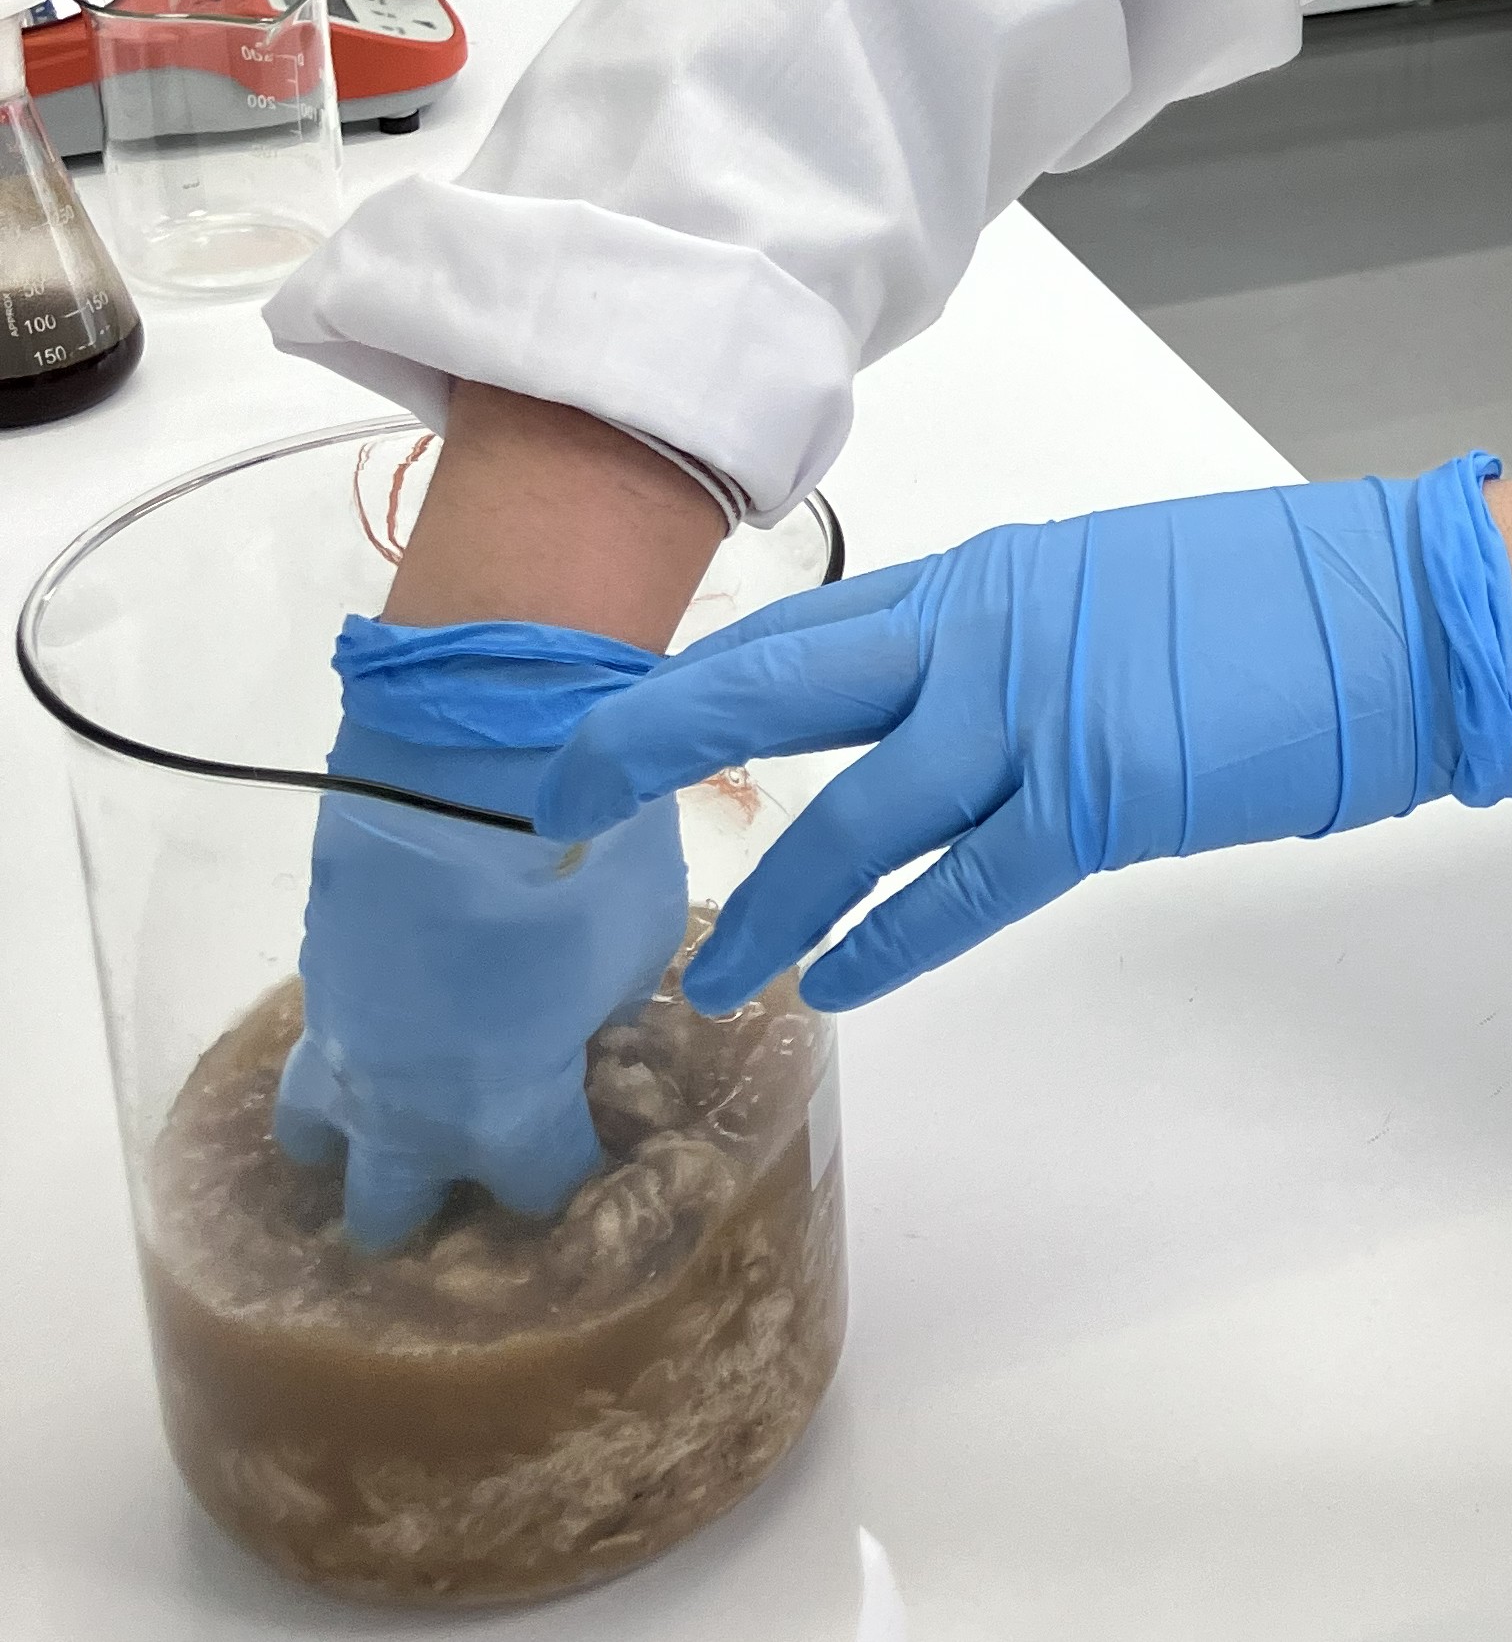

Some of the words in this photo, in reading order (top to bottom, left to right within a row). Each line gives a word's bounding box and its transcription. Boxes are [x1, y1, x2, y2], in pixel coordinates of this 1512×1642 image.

[85, 291, 109, 313] 150
[24, 314, 56, 334] 100
[34, 345, 67, 367] 150
